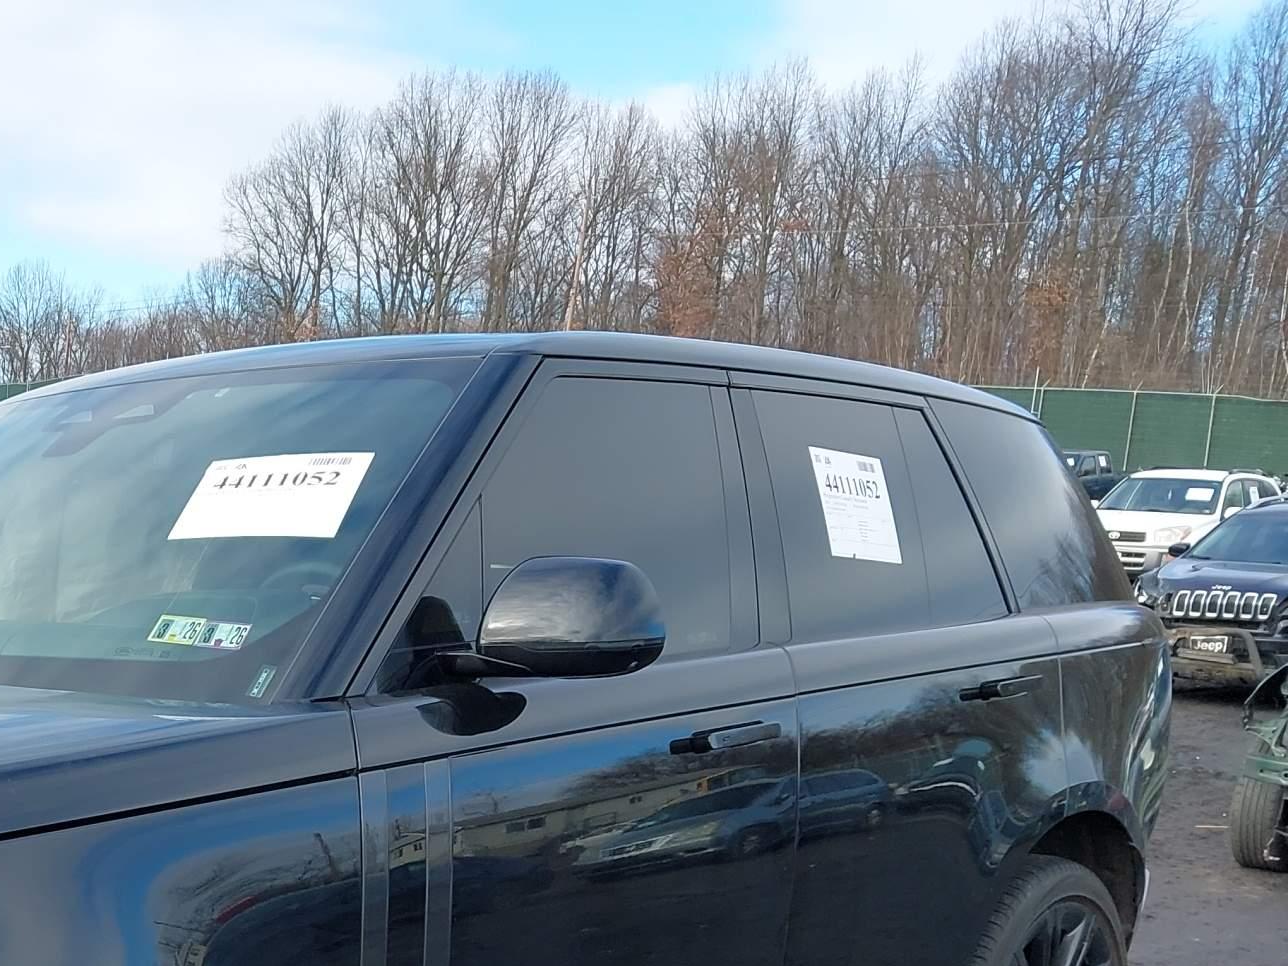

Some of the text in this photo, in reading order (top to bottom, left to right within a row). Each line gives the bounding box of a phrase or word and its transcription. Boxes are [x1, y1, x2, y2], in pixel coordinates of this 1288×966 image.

[213, 471, 341, 489] 44111052
[824, 473, 881, 499] 44111052
[229, 626, 247, 645] 26
[1194, 641, 1224, 653] Jeep
